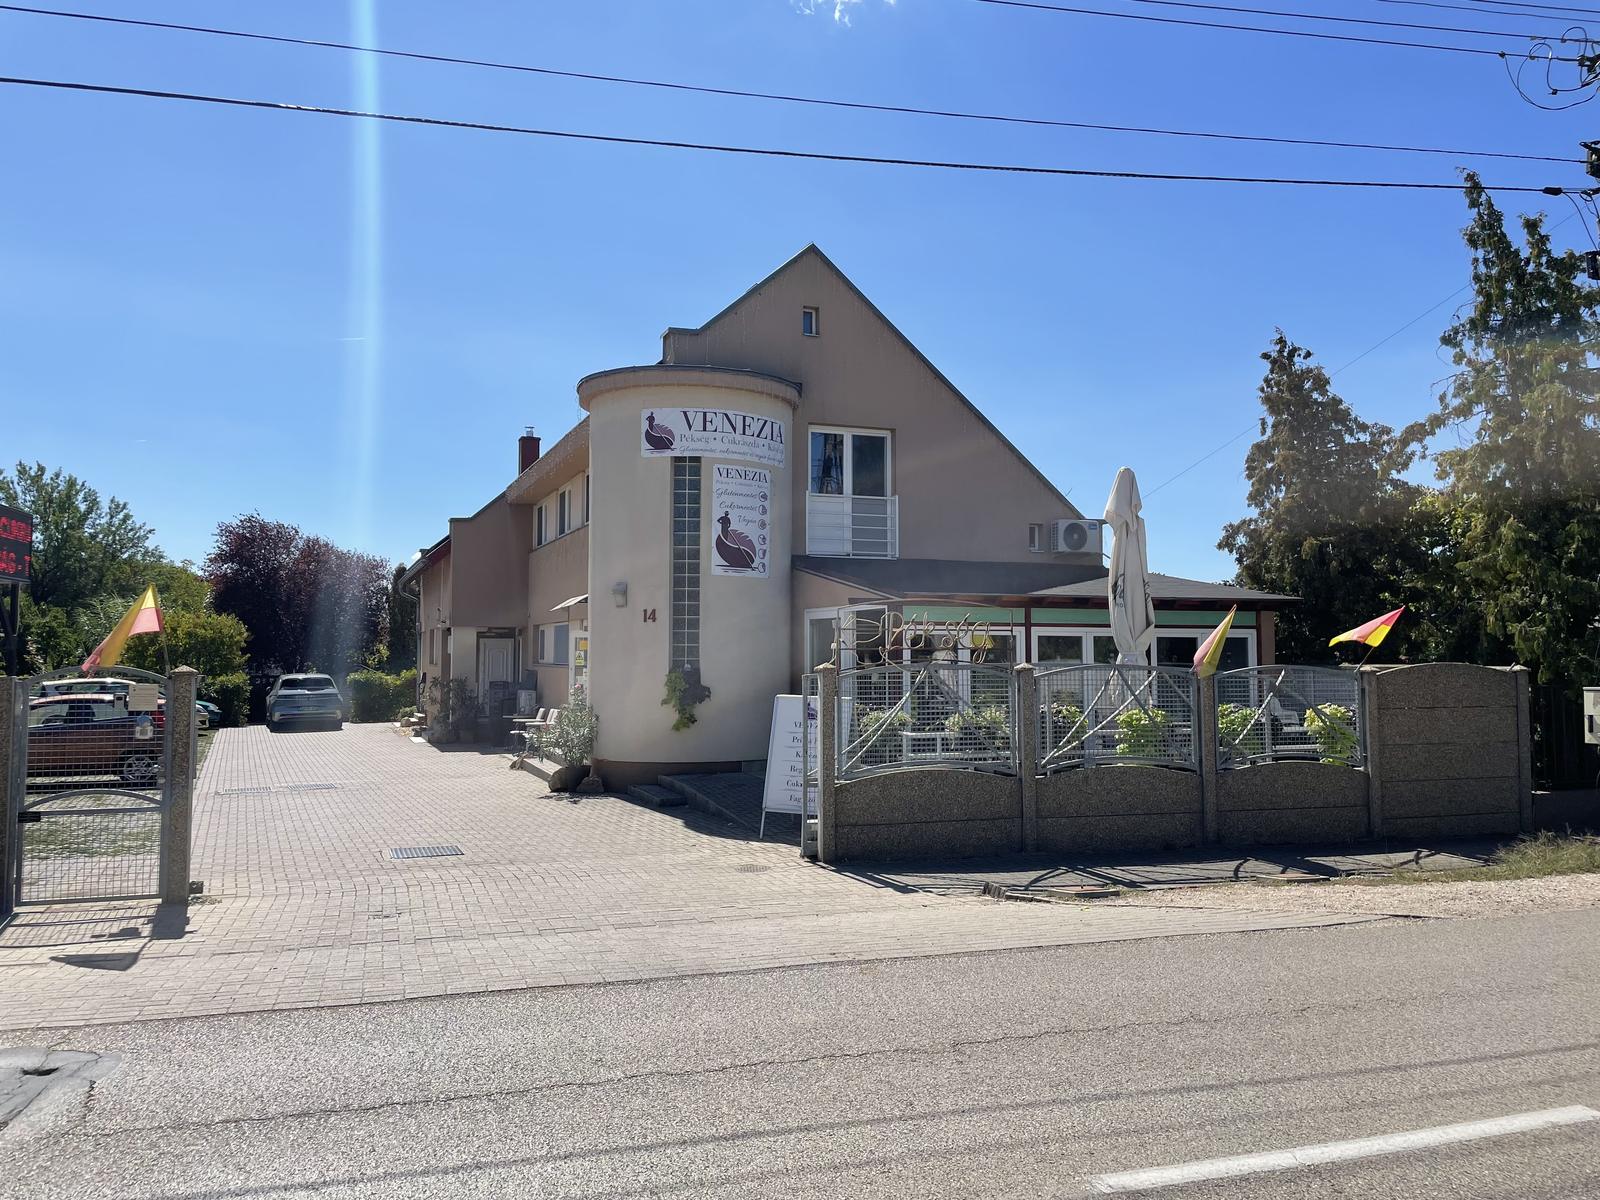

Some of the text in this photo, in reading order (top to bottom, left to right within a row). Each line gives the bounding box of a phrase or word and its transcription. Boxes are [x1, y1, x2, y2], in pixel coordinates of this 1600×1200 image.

[679, 410, 784, 444] VENEZIA
[717, 467, 768, 483] VENEZIA
[643, 608, 657, 623] 14
